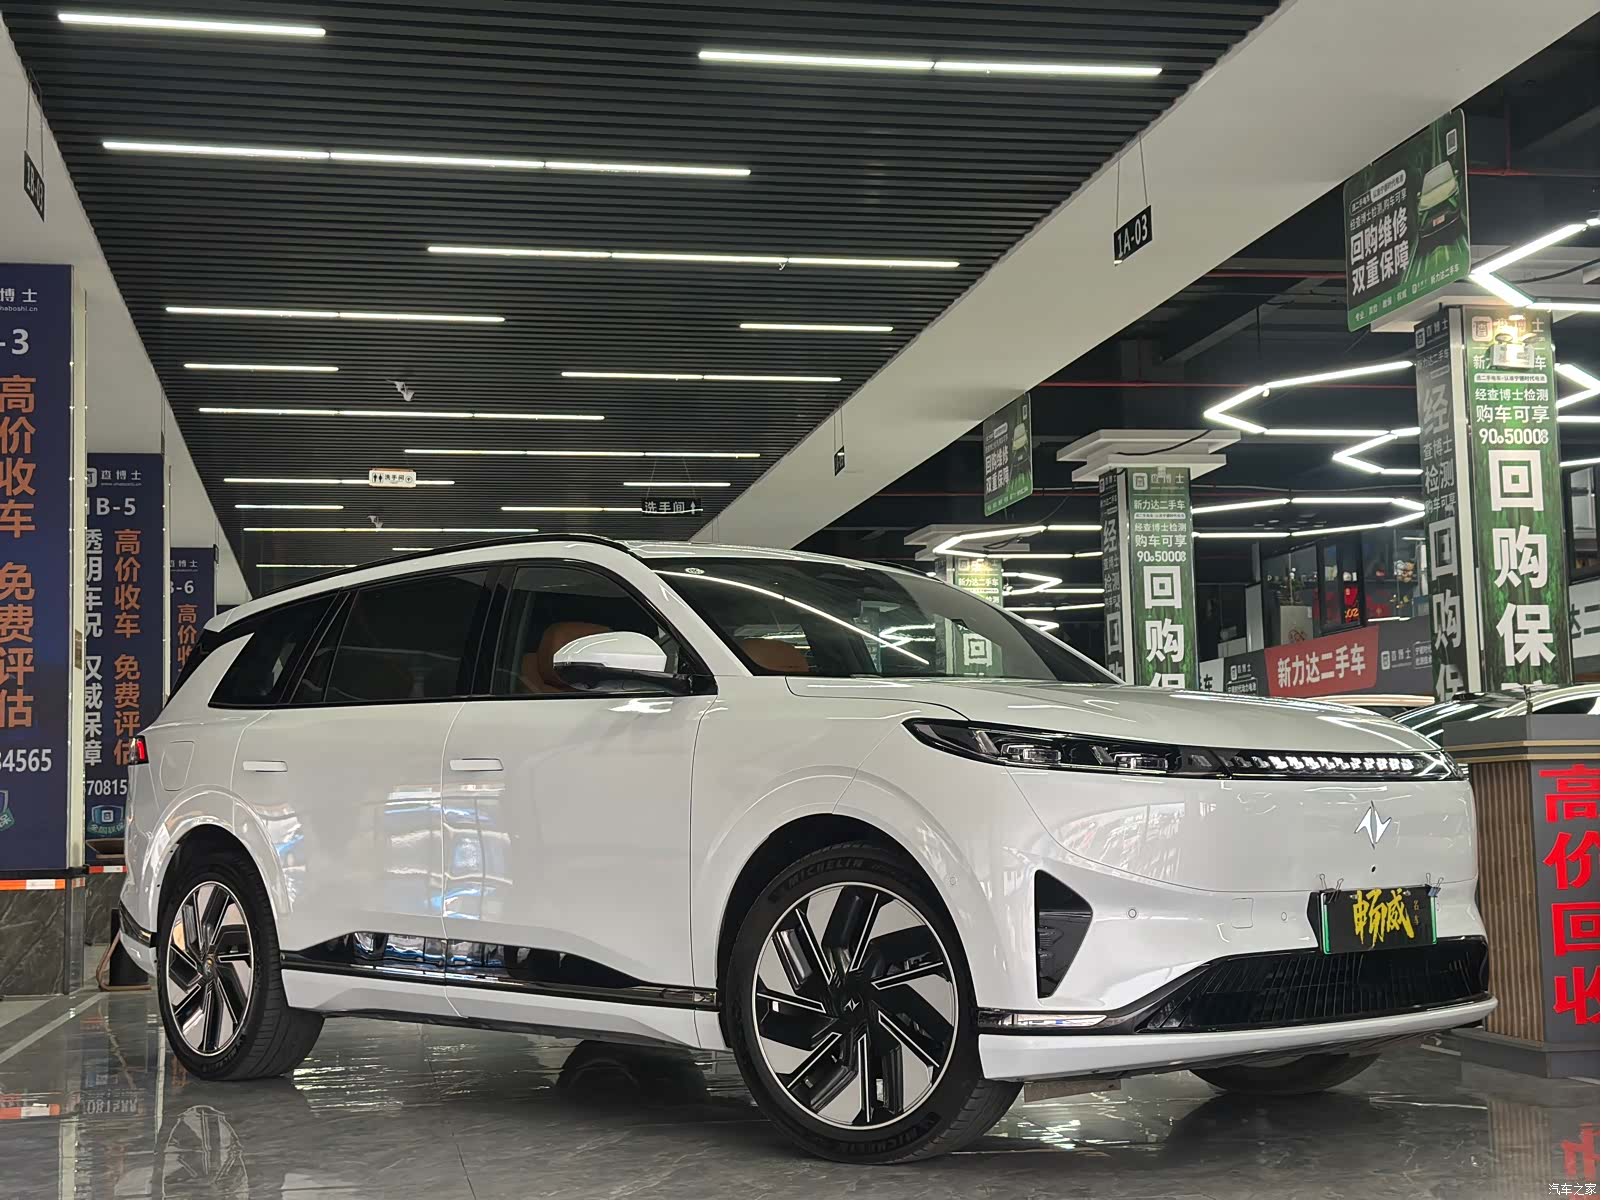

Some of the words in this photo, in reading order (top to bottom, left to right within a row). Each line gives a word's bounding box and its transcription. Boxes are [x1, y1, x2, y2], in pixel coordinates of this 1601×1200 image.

[1118, 213, 1148, 258] 1A-03
[1350, 207, 1408, 266] 回购维修
[1352, 240, 1409, 296] 双重保障
[1423, 383, 1449, 435] 经
[1475, 387, 1549, 402] 经查博士检测
[1476, 404, 1550, 424] 购车可享
[0, 374, 37, 539] 高价收车
[1423, 434, 1453, 462] 查博士
[101, 469, 142, 481] 查博士
[1425, 457, 1455, 495] 检测
[644, 501, 685, 514] 洗手间
[1133, 499, 1186, 511] 新力达二手车
[1135, 522, 1187, 533] 经查博士检测
[1135, 534, 1188, 549] 购车可享
[114, 528, 142, 640] 高价收车
[1488, 449, 1557, 691] 回购保
[0, 561, 35, 728] 免费评估
[1277, 642, 1367, 689] 新力达二手车
[0, 748, 52, 773] 4565
[85, 778, 128, 796] 70815
